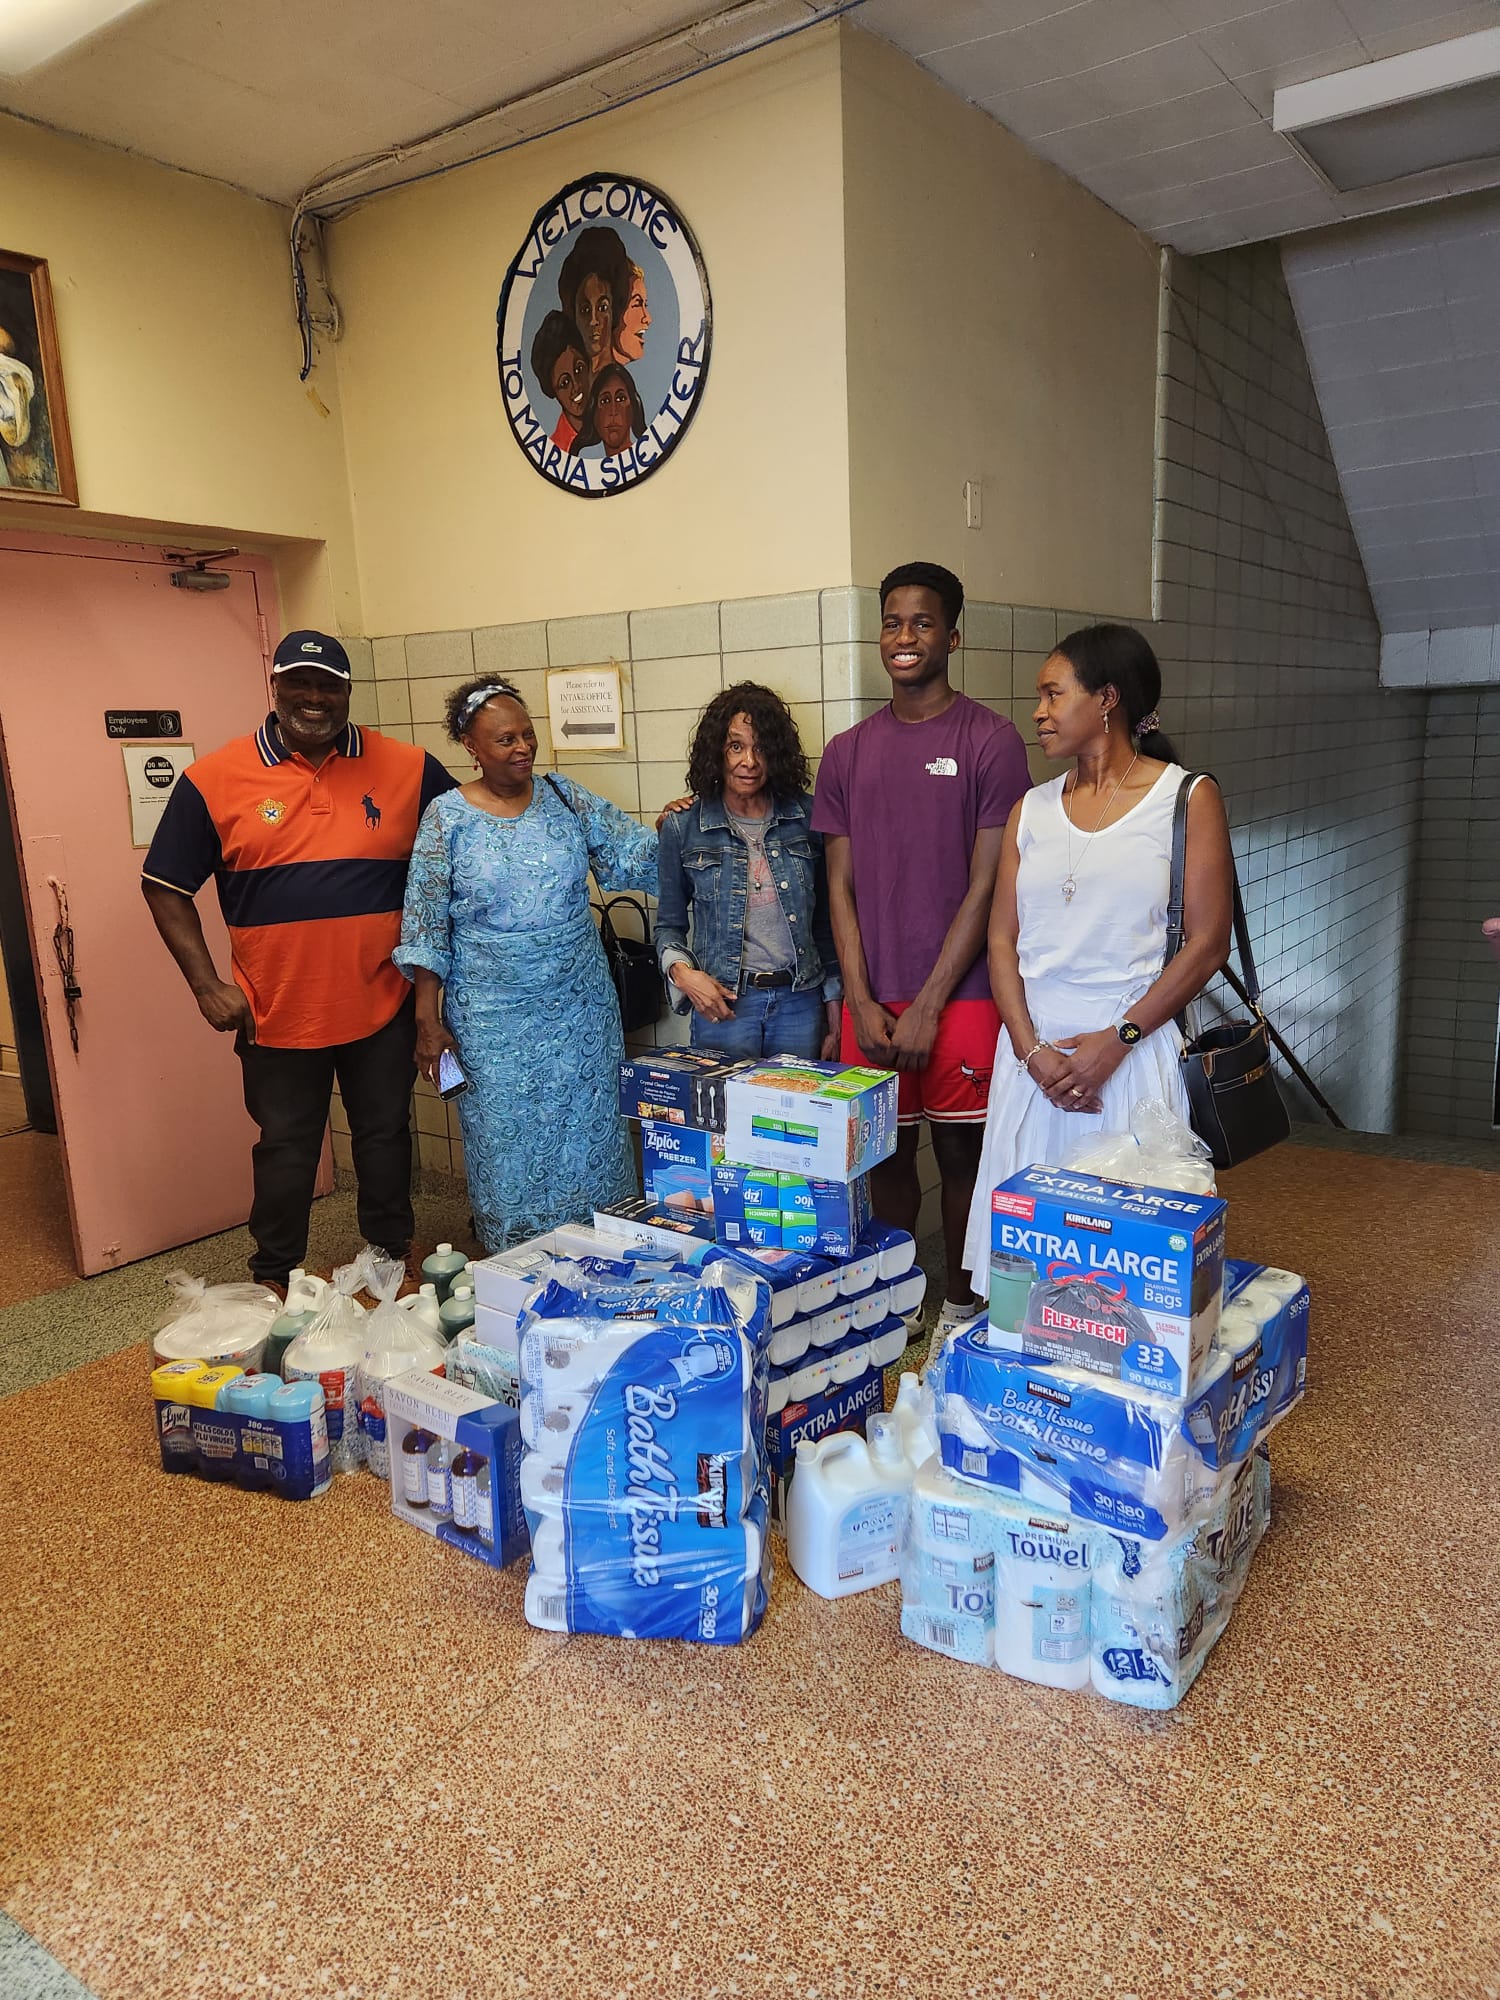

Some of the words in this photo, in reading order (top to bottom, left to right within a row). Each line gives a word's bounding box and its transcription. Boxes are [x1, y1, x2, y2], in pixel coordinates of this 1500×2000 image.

[516, 184, 677, 278] WELCOME
[501, 350, 523, 399] TO
[512, 408, 590, 490] MARIA
[600, 319, 706, 488] SHELTER
[566, 680, 582, 689] Please
[583, 680, 597, 688] refer
[560, 693, 585, 701] INTAKE
[586, 692, 613, 700] OFFICE
[560, 705, 569, 714] for
[108, 716, 148, 725] Employees
[109, 725, 127, 734] Only
[147, 761, 156, 769] DO
[151, 776, 170, 784] ENTER
[620, 1066, 634, 1078] 360
[887, 1080, 895, 1111] Ziploc
[875, 1091, 883, 1155] PROTECTION
[647, 1131, 680, 1151] Ziploc
[658, 1151, 696, 1165] FREEZER
[717, 1171, 734, 1180] 480
[1100, 1176, 1145, 1189] KIRKLAND
[723, 1187, 730, 1195] 4
[1024, 1172, 1104, 1196] EXTRA
[1111, 1190, 1203, 1215] LARGE
[1057, 1187, 1109, 1204] GALLON
[1120, 1203, 1160, 1217] Bags
[1065, 1213, 1112, 1230] KIRKLAND
[823, 1244, 848, 1255] Ziploc
[1001, 1224, 1083, 1265] EXTRA
[1089, 1243, 1179, 1285] LARGE
[1196, 1243, 1212, 1266] EXTRA
[1143, 1289, 1183, 1310] Bags
[614, 1312, 655, 1320] KIRKLAND
[1042, 1305, 1127, 1346] FLEX-TECH
[714, 1343, 726, 1371] SHEETS
[722, 1345, 732, 1366] WIDE
[1137, 1344, 1164, 1368] 33
[1137, 1362, 1164, 1374] GALLON
[1129, 1372, 1142, 1383] 90
[1143, 1374, 1174, 1392] BAGS
[389, 1389, 419, 1409] SAVON
[1029, 1383, 1071, 1404] KIRKLAND
[164, 1406, 188, 1426] Lysol
[790, 1408, 837, 1450] EXTRA
[839, 1378, 880, 1420] LARGE
[1003, 1388, 1046, 1419] Bath
[1045, 1403, 1095, 1435] Tissue
[192, 1422, 212, 1436] KILLS
[212, 1426, 229, 1438] COLD
[195, 1432, 208, 1442] FLU
[209, 1434, 235, 1446] VIRUSES
[606, 1428, 616, 1452] Soft
[625, 1384, 677, 1486] Bath
[984, 1404, 1043, 1440] Bath
[1043, 1424, 1107, 1462] Tissue
[606, 1455, 614, 1473] and
[1094, 1490, 1113, 1509] 30
[1116, 1500, 1146, 1520] 380
[627, 1485, 679, 1588] Tissue
[1024, 1531, 1071, 1548] PREMIUM
[1006, 1532, 1089, 1568] Towel
[705, 1584, 719, 1606] 30
[702, 1608, 718, 1639] 380
[1108, 1652, 1131, 1671] 12
